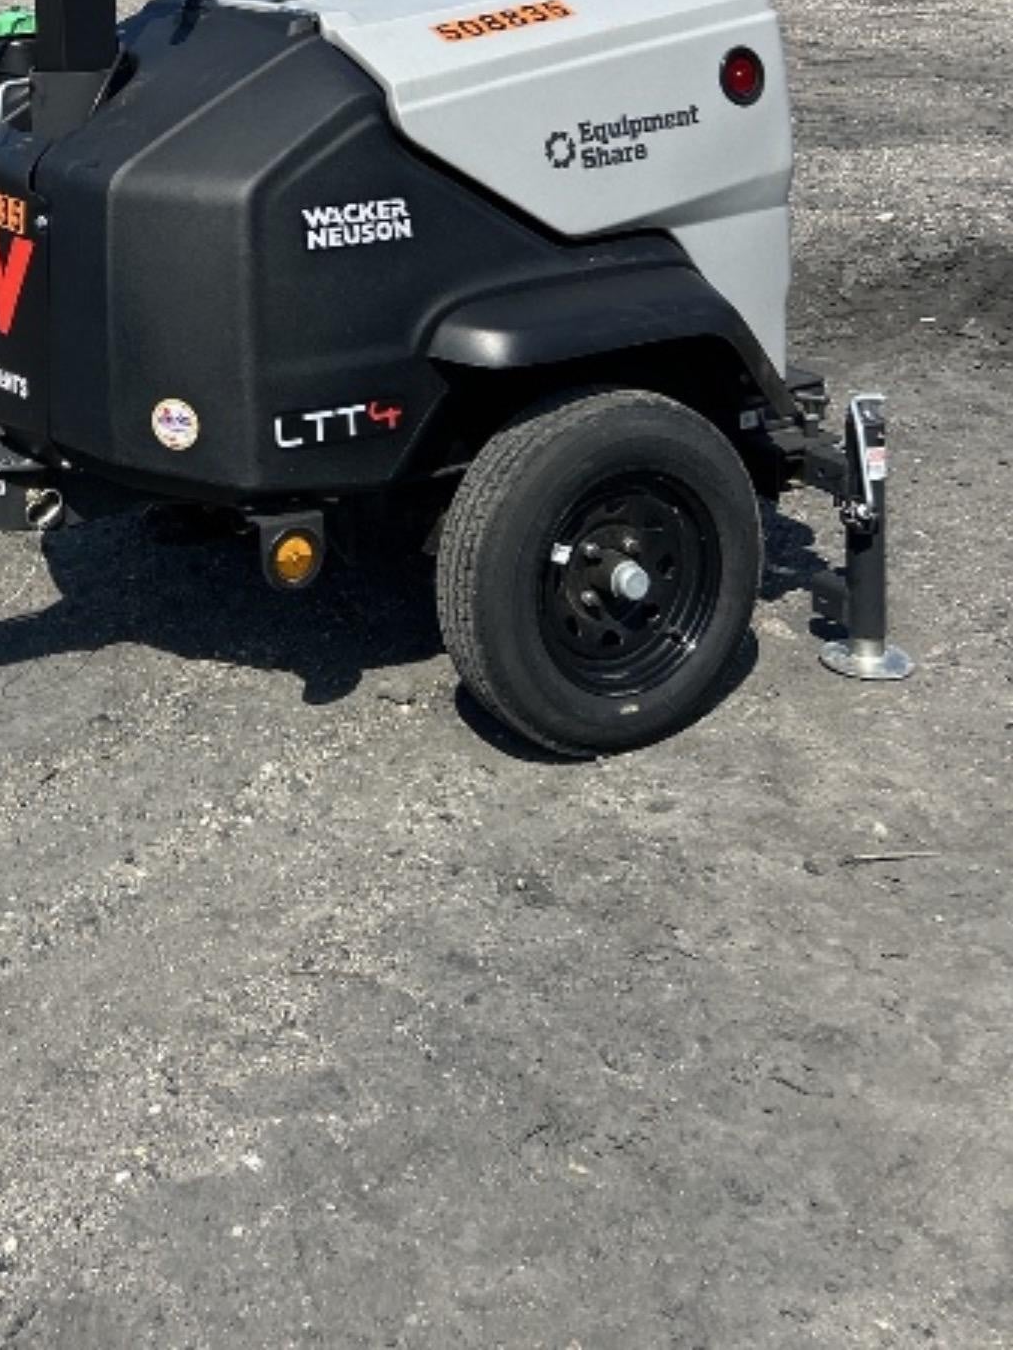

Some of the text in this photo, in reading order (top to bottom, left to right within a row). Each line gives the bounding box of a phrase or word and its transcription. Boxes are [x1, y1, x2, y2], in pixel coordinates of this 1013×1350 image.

[577, 104, 700, 144] Equipment
[581, 143, 648, 169] Share
[301, 197, 411, 229] WACKER
[307, 218, 413, 250] NEUSON
[274, 400, 402, 448] LTT4
